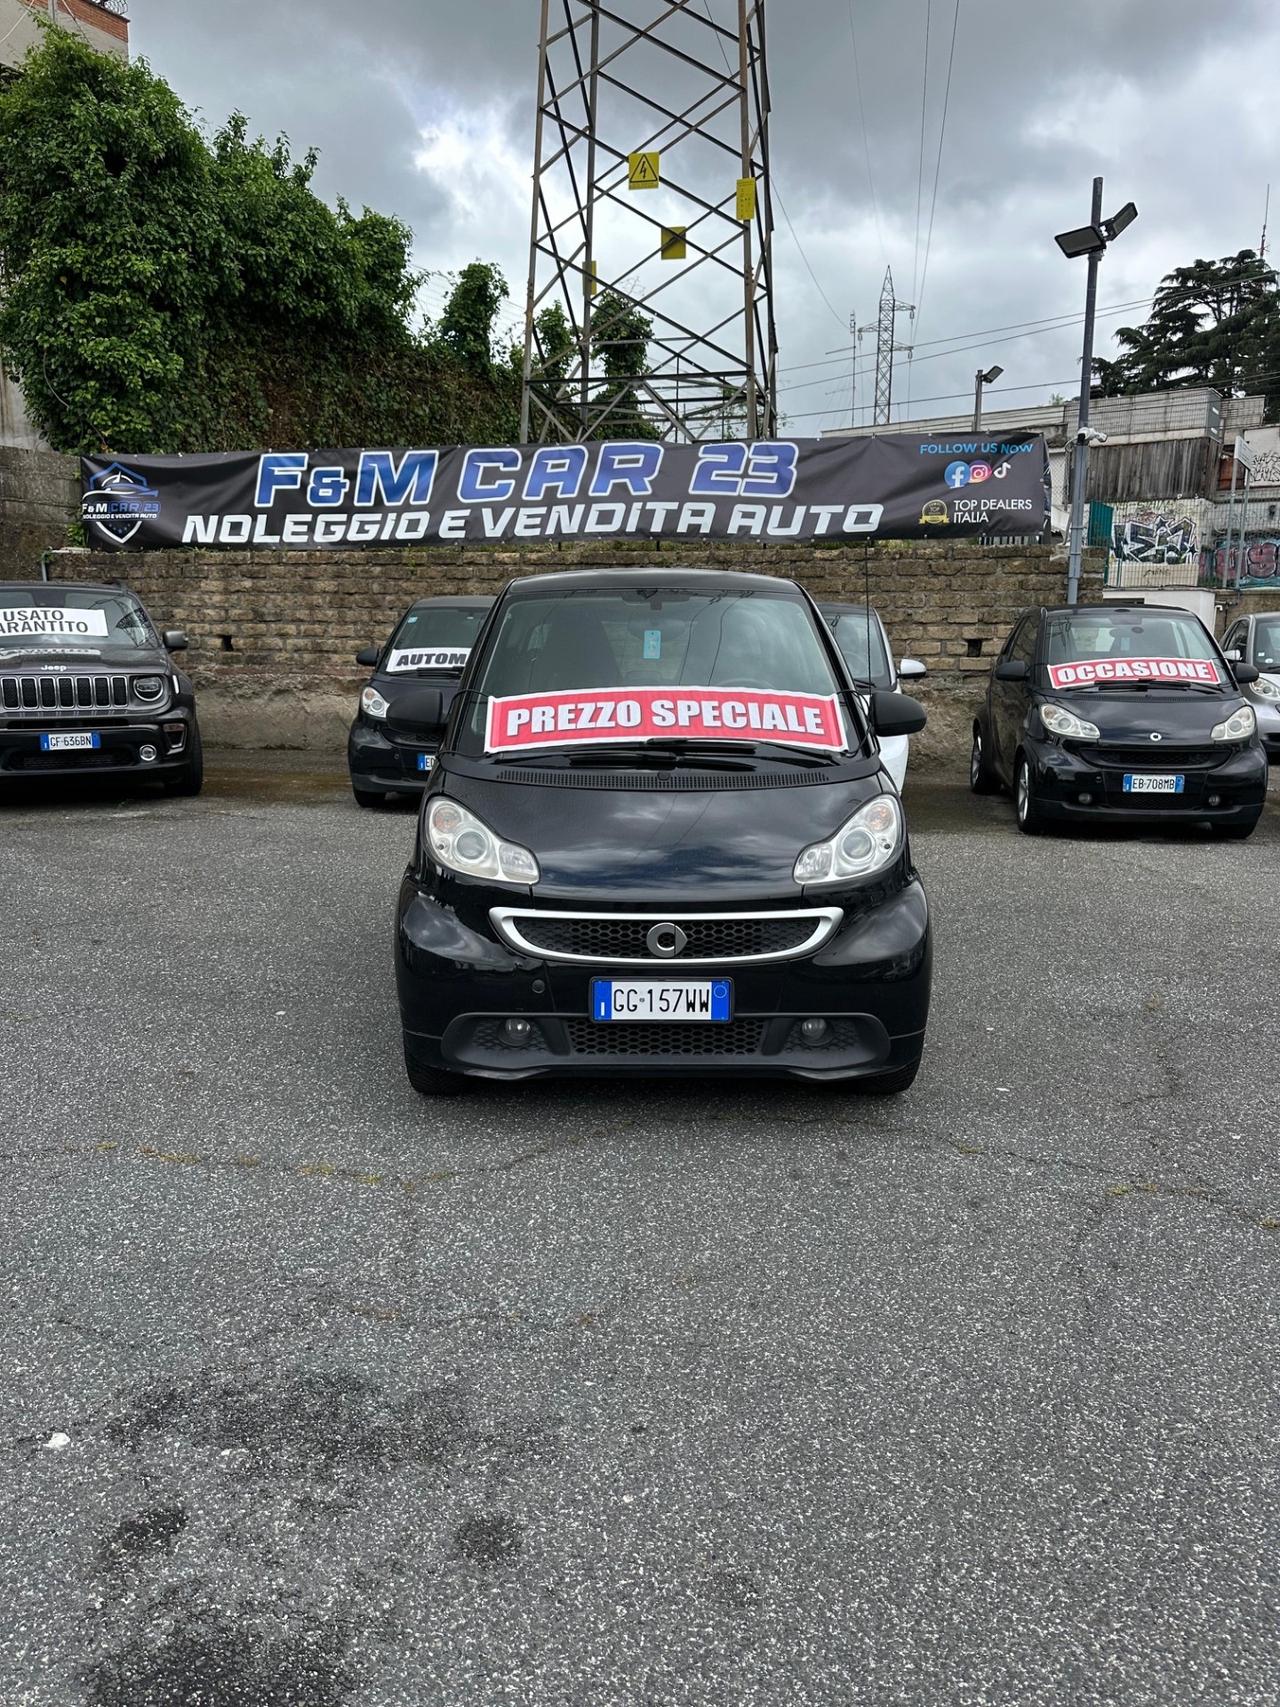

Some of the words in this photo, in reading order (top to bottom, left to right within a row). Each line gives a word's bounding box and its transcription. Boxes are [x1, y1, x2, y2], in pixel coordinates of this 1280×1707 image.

[920, 443, 977, 454] FOLLOW
[981, 442, 998, 454] US
[1000, 443, 1033, 455] NOW
[254, 450, 440, 507] F&M
[456, 442, 664, 502] CAR
[688, 441, 799, 498] 23
[109, 501, 141, 513] CAR
[143, 502, 160, 513] 23
[953, 499, 977, 511] TOP
[980, 499, 1033, 510] DEALERS
[181, 511, 431, 544] NOLEGGIO
[440, 507, 472, 539] E
[480, 500, 716, 539] VENDITA
[726, 502, 885, 536] AUTO
[953, 512, 989, 524] ITALIA
[3, 609, 65, 622] USATO
[1057, 661, 1212, 683] OCCASIONE
[506, 699, 642, 737] PREZZO
[650, 699, 825, 736] SPECIALE
